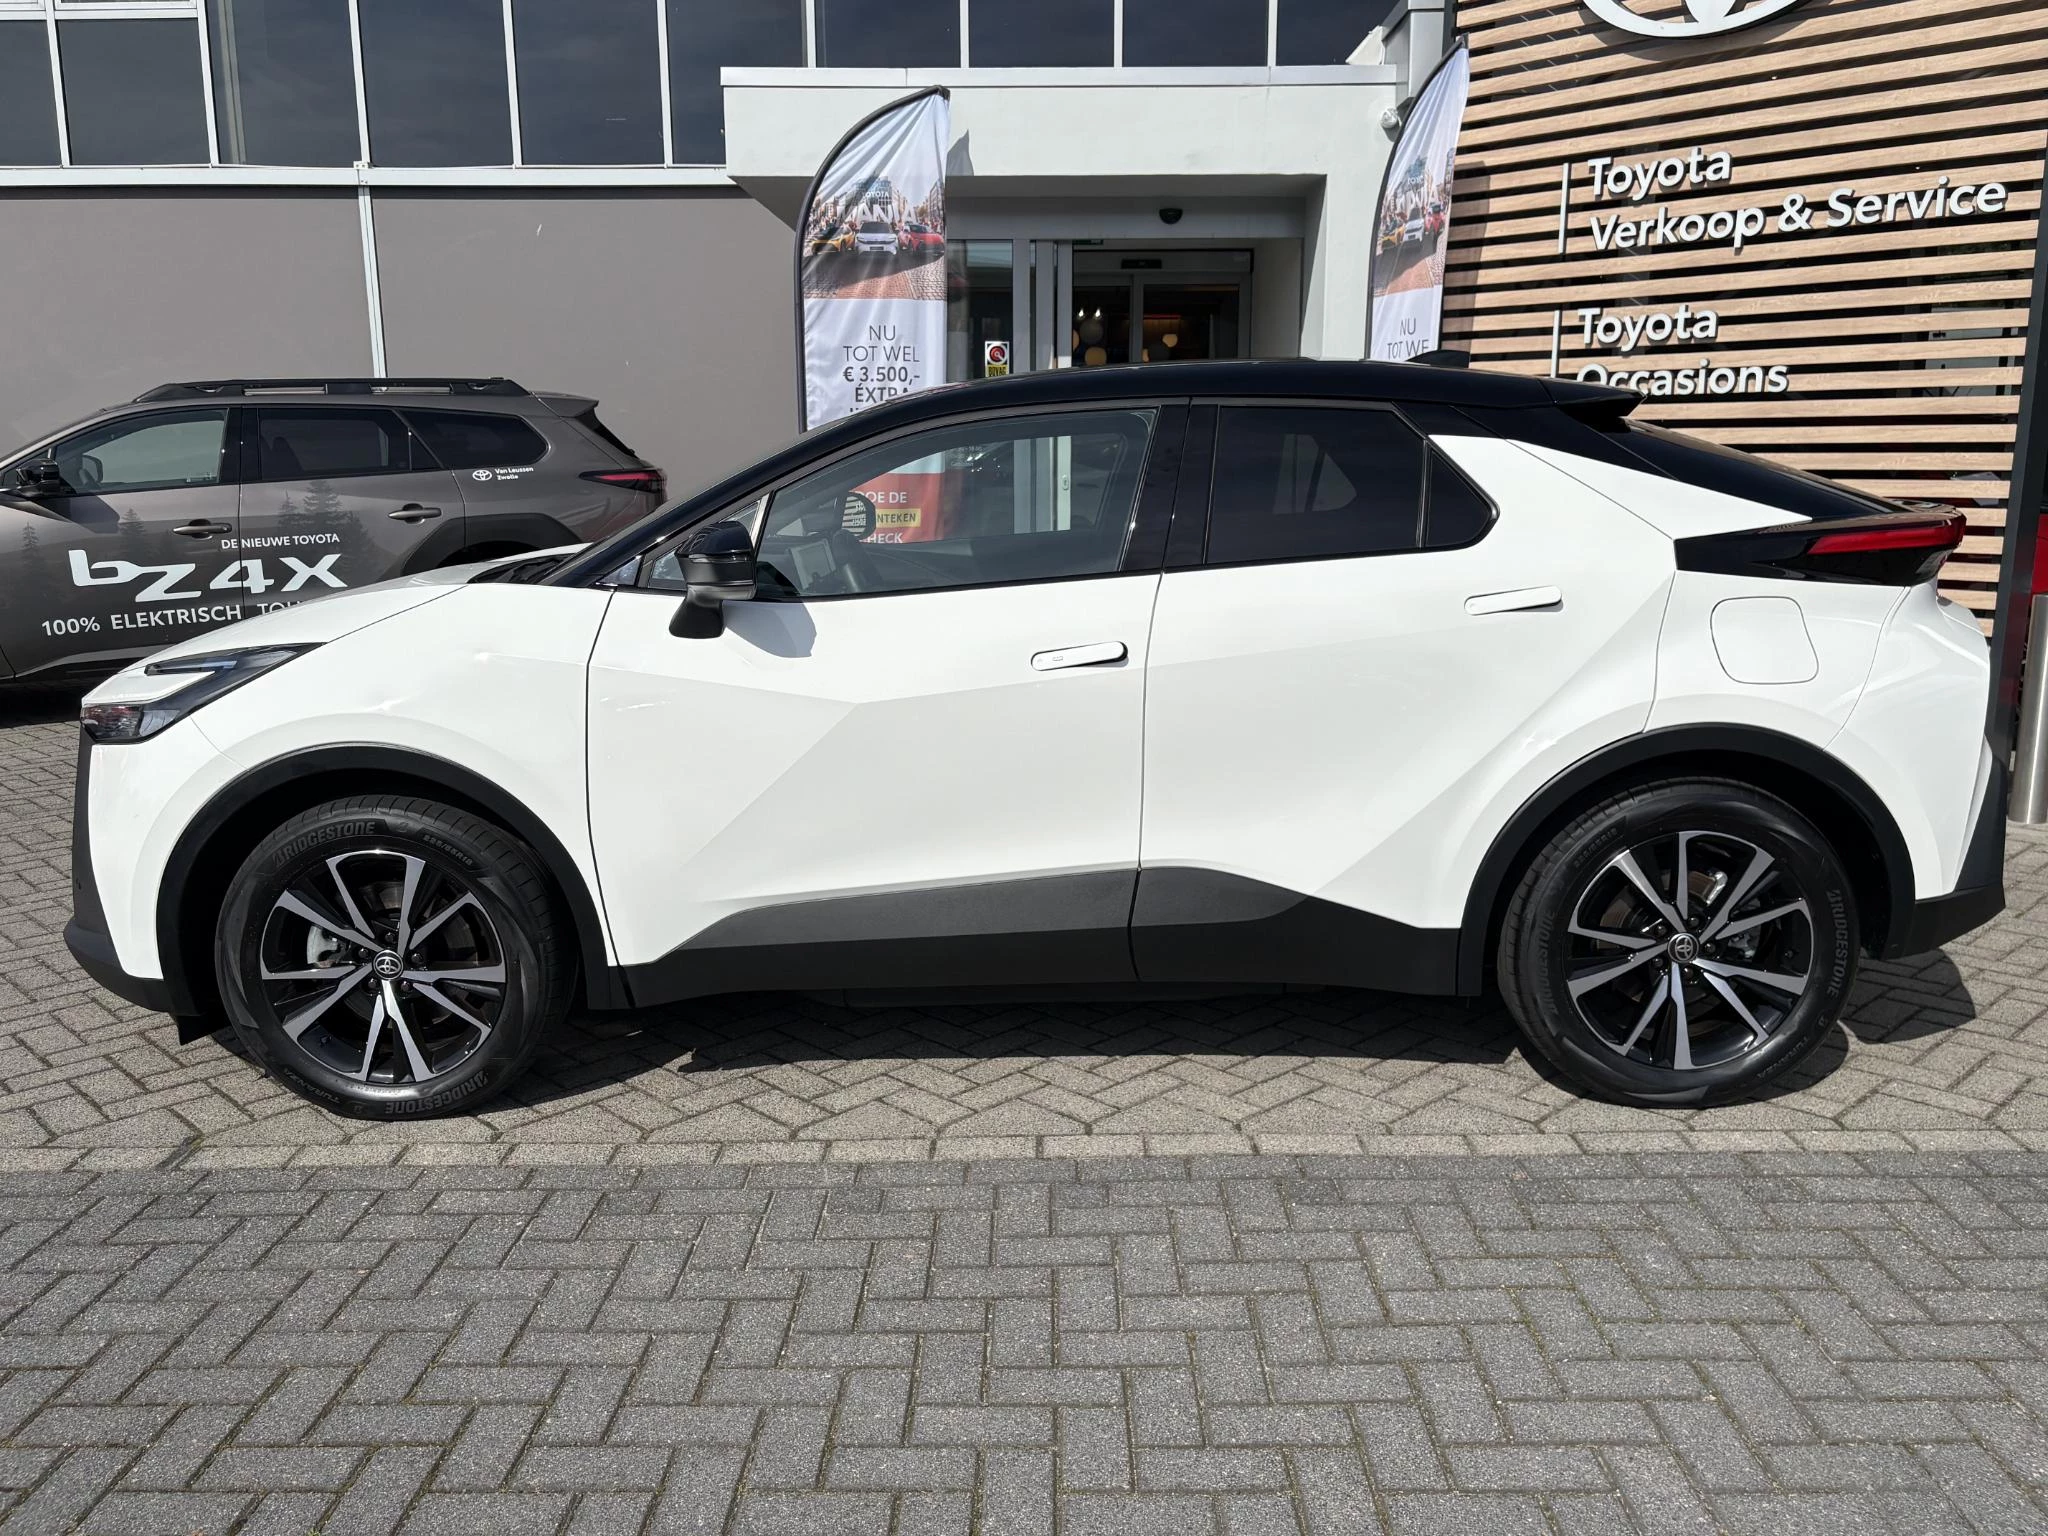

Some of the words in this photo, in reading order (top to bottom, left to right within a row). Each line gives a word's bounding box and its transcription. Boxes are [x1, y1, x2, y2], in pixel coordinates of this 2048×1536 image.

[1588, 147, 1732, 201] Toyota
[1590, 207, 1765, 249] Verkoop
[1778, 193, 1812, 232] &
[1826, 176, 2007, 227] Service
[869, 325, 896, 341] NU
[1400, 317, 1417, 336] NU
[1578, 304, 1718, 351] Toyota
[843, 345, 878, 362] TOT
[883, 345, 920, 362] WEL
[1387, 341, 1403, 360] TOT
[843, 366, 855, 382] €
[860, 366, 920, 386] 3.500,-
[1577, 359, 1788, 396] Occasions
[889, 491, 907, 503] DE
[877, 512, 917, 523] NTEKEN
[221, 539, 238, 549] DE
[241, 536, 291, 548] NIEUWE
[292, 533, 340, 545] TOYOTA
[42, 616, 100, 636] 100%
[110, 604, 242, 630] ELEKTRISCH
[271, 821, 376, 866] BRIDGESTONE
[1827, 889, 1850, 998] BRIDGESTONE
[384, 1071, 489, 1115] BRIDGESTONE
